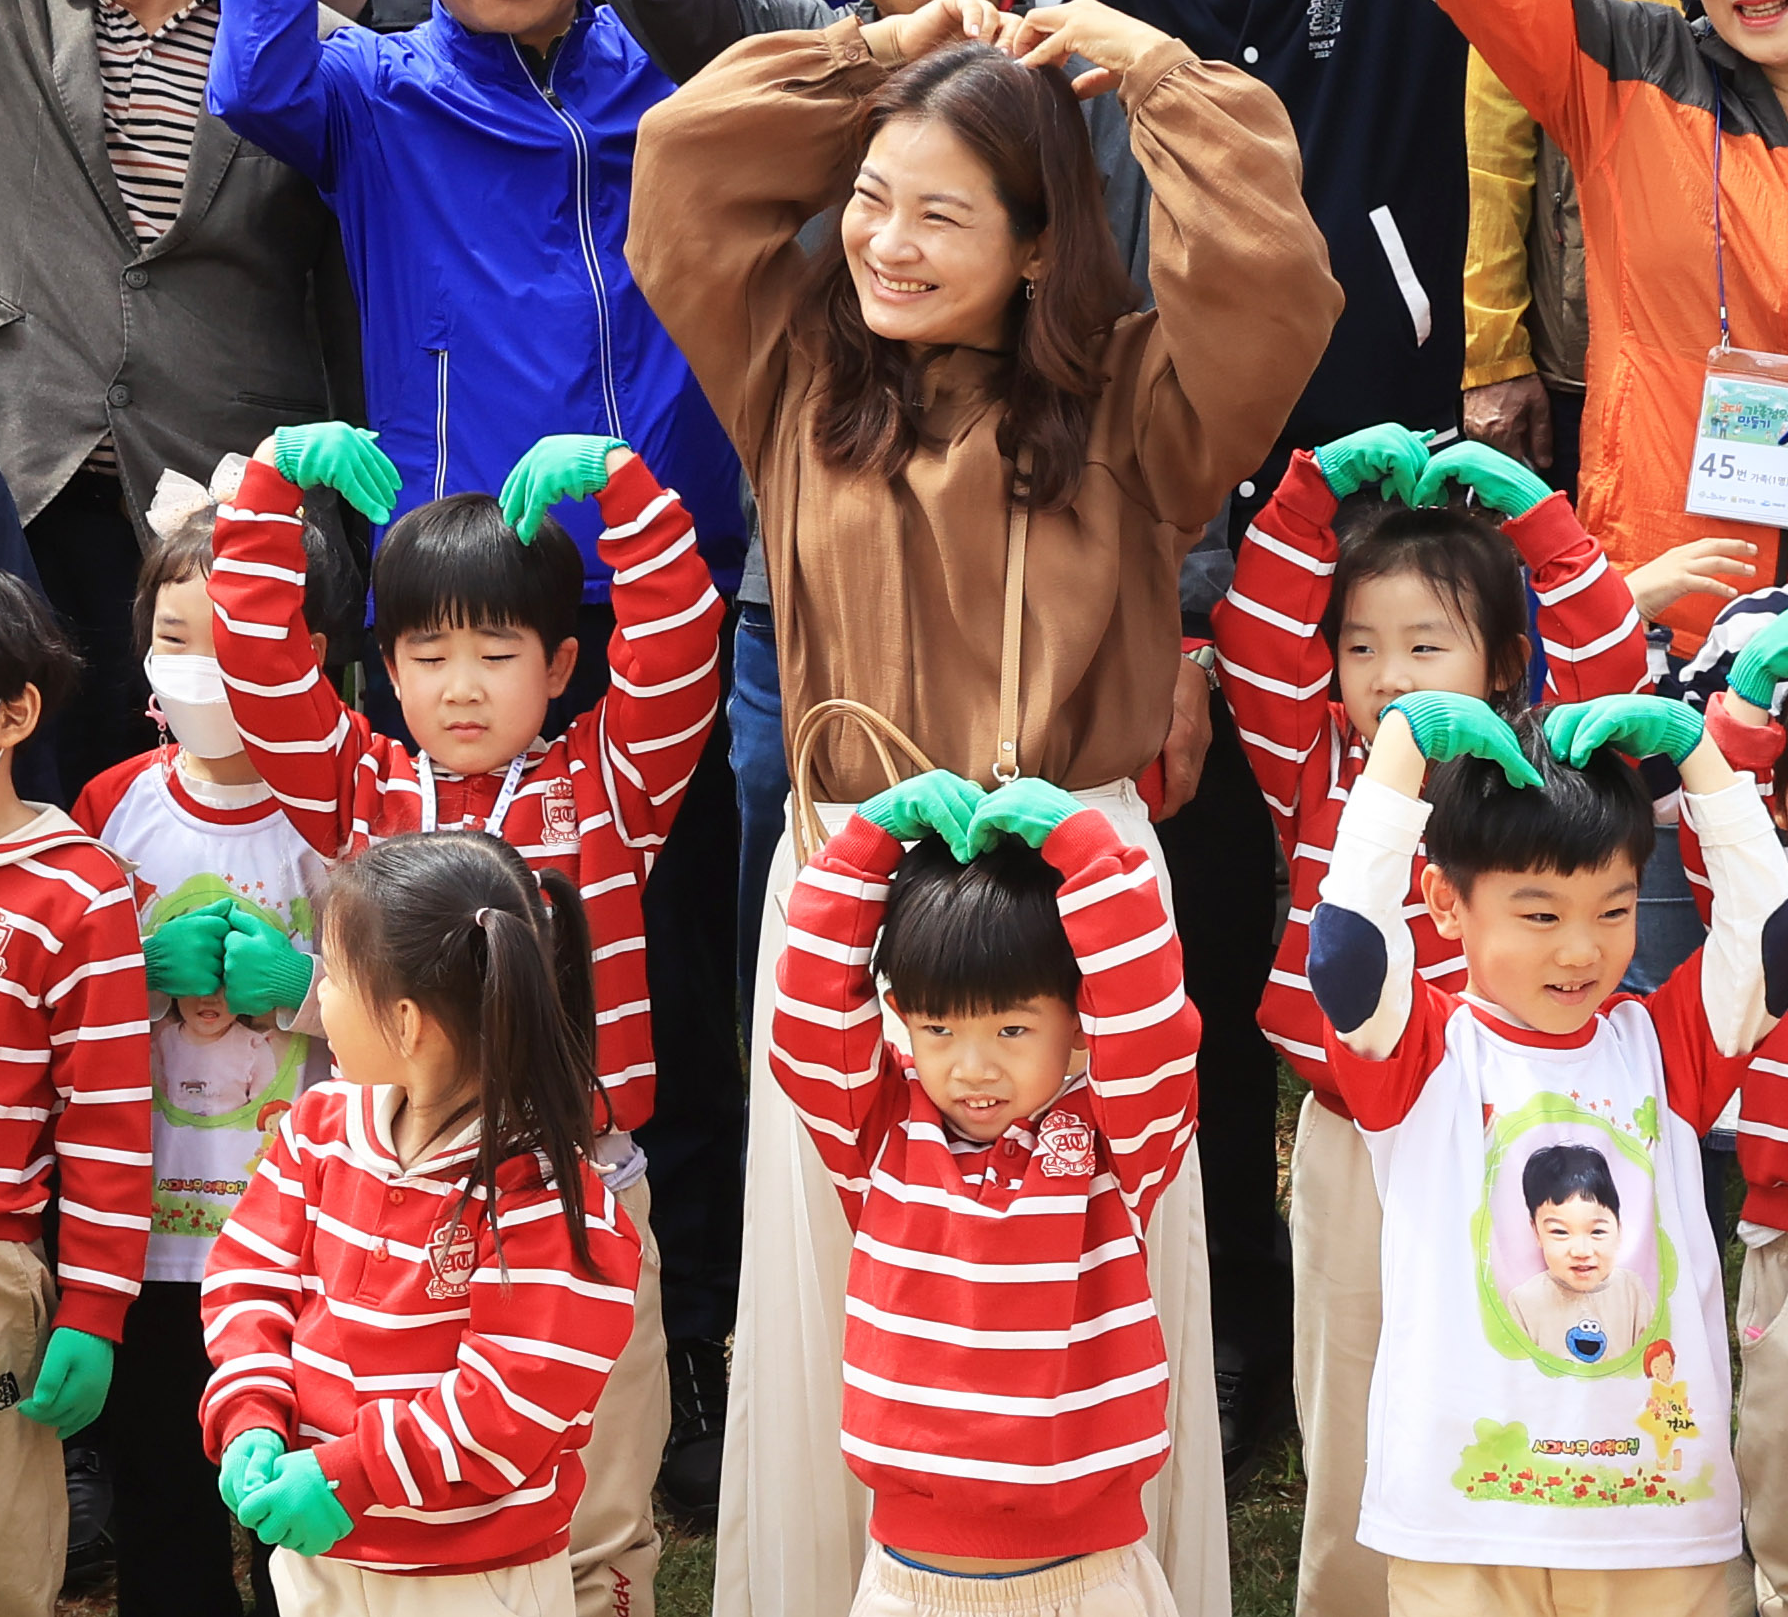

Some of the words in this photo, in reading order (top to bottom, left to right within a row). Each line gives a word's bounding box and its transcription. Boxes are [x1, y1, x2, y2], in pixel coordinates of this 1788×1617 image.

[1737, 415, 1771, 430] 만들기
[158, 1179, 202, 1192] 사과나무
[1532, 1438, 1588, 1457] 사과나무
[1589, 1438, 1640, 1457] 어린이집
